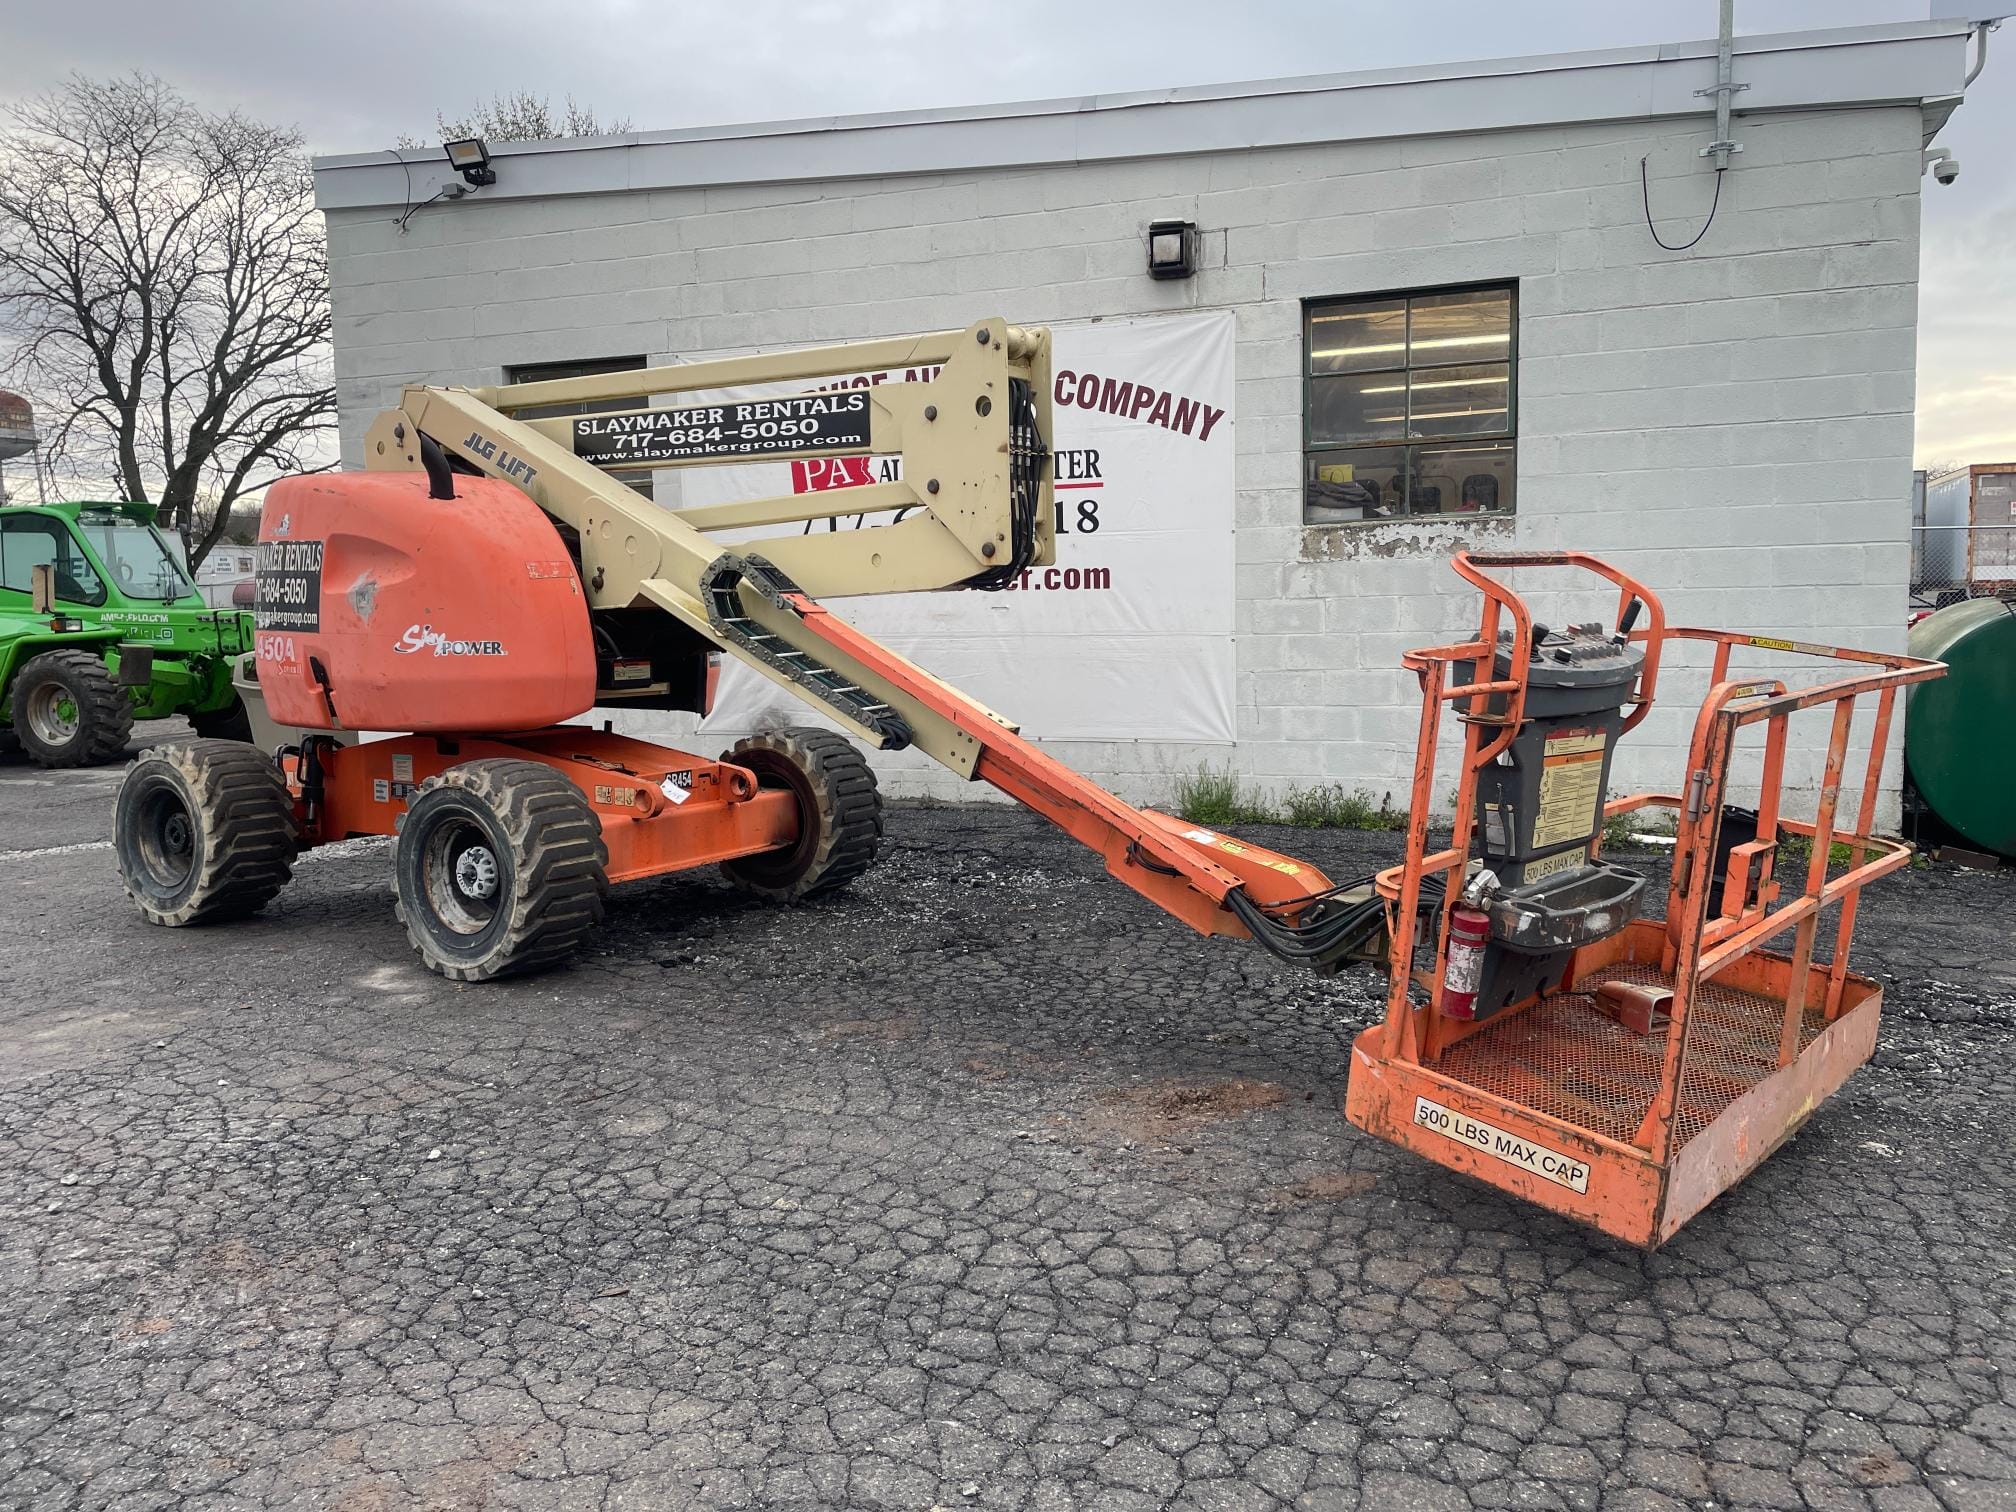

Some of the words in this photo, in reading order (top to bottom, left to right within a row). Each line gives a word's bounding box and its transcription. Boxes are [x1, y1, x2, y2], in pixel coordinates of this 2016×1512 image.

[577, 407, 725, 436] SLAYMAKER
[735, 394, 865, 422] RENTALS
[1054, 370, 1225, 442] COMPANY
[580, 433, 863, 462] www.slaymakergroup.com
[613, 418, 819, 450] 717-684-5050
[463, 431, 498, 461] JLG
[495, 450, 538, 485] LIFT
[800, 458, 854, 493] PA
[284, 544, 323, 572] RENTALS
[257, 635, 296, 662] 450A
[1757, 639, 1793, 650] CAUTION
[1569, 851, 1584, 867] CAP
[1418, 1105, 1450, 1129] 500
[1454, 1118, 1490, 1145] LBS
[1495, 1135, 1537, 1166] MAX
[1542, 1156, 1584, 1182] CAP
